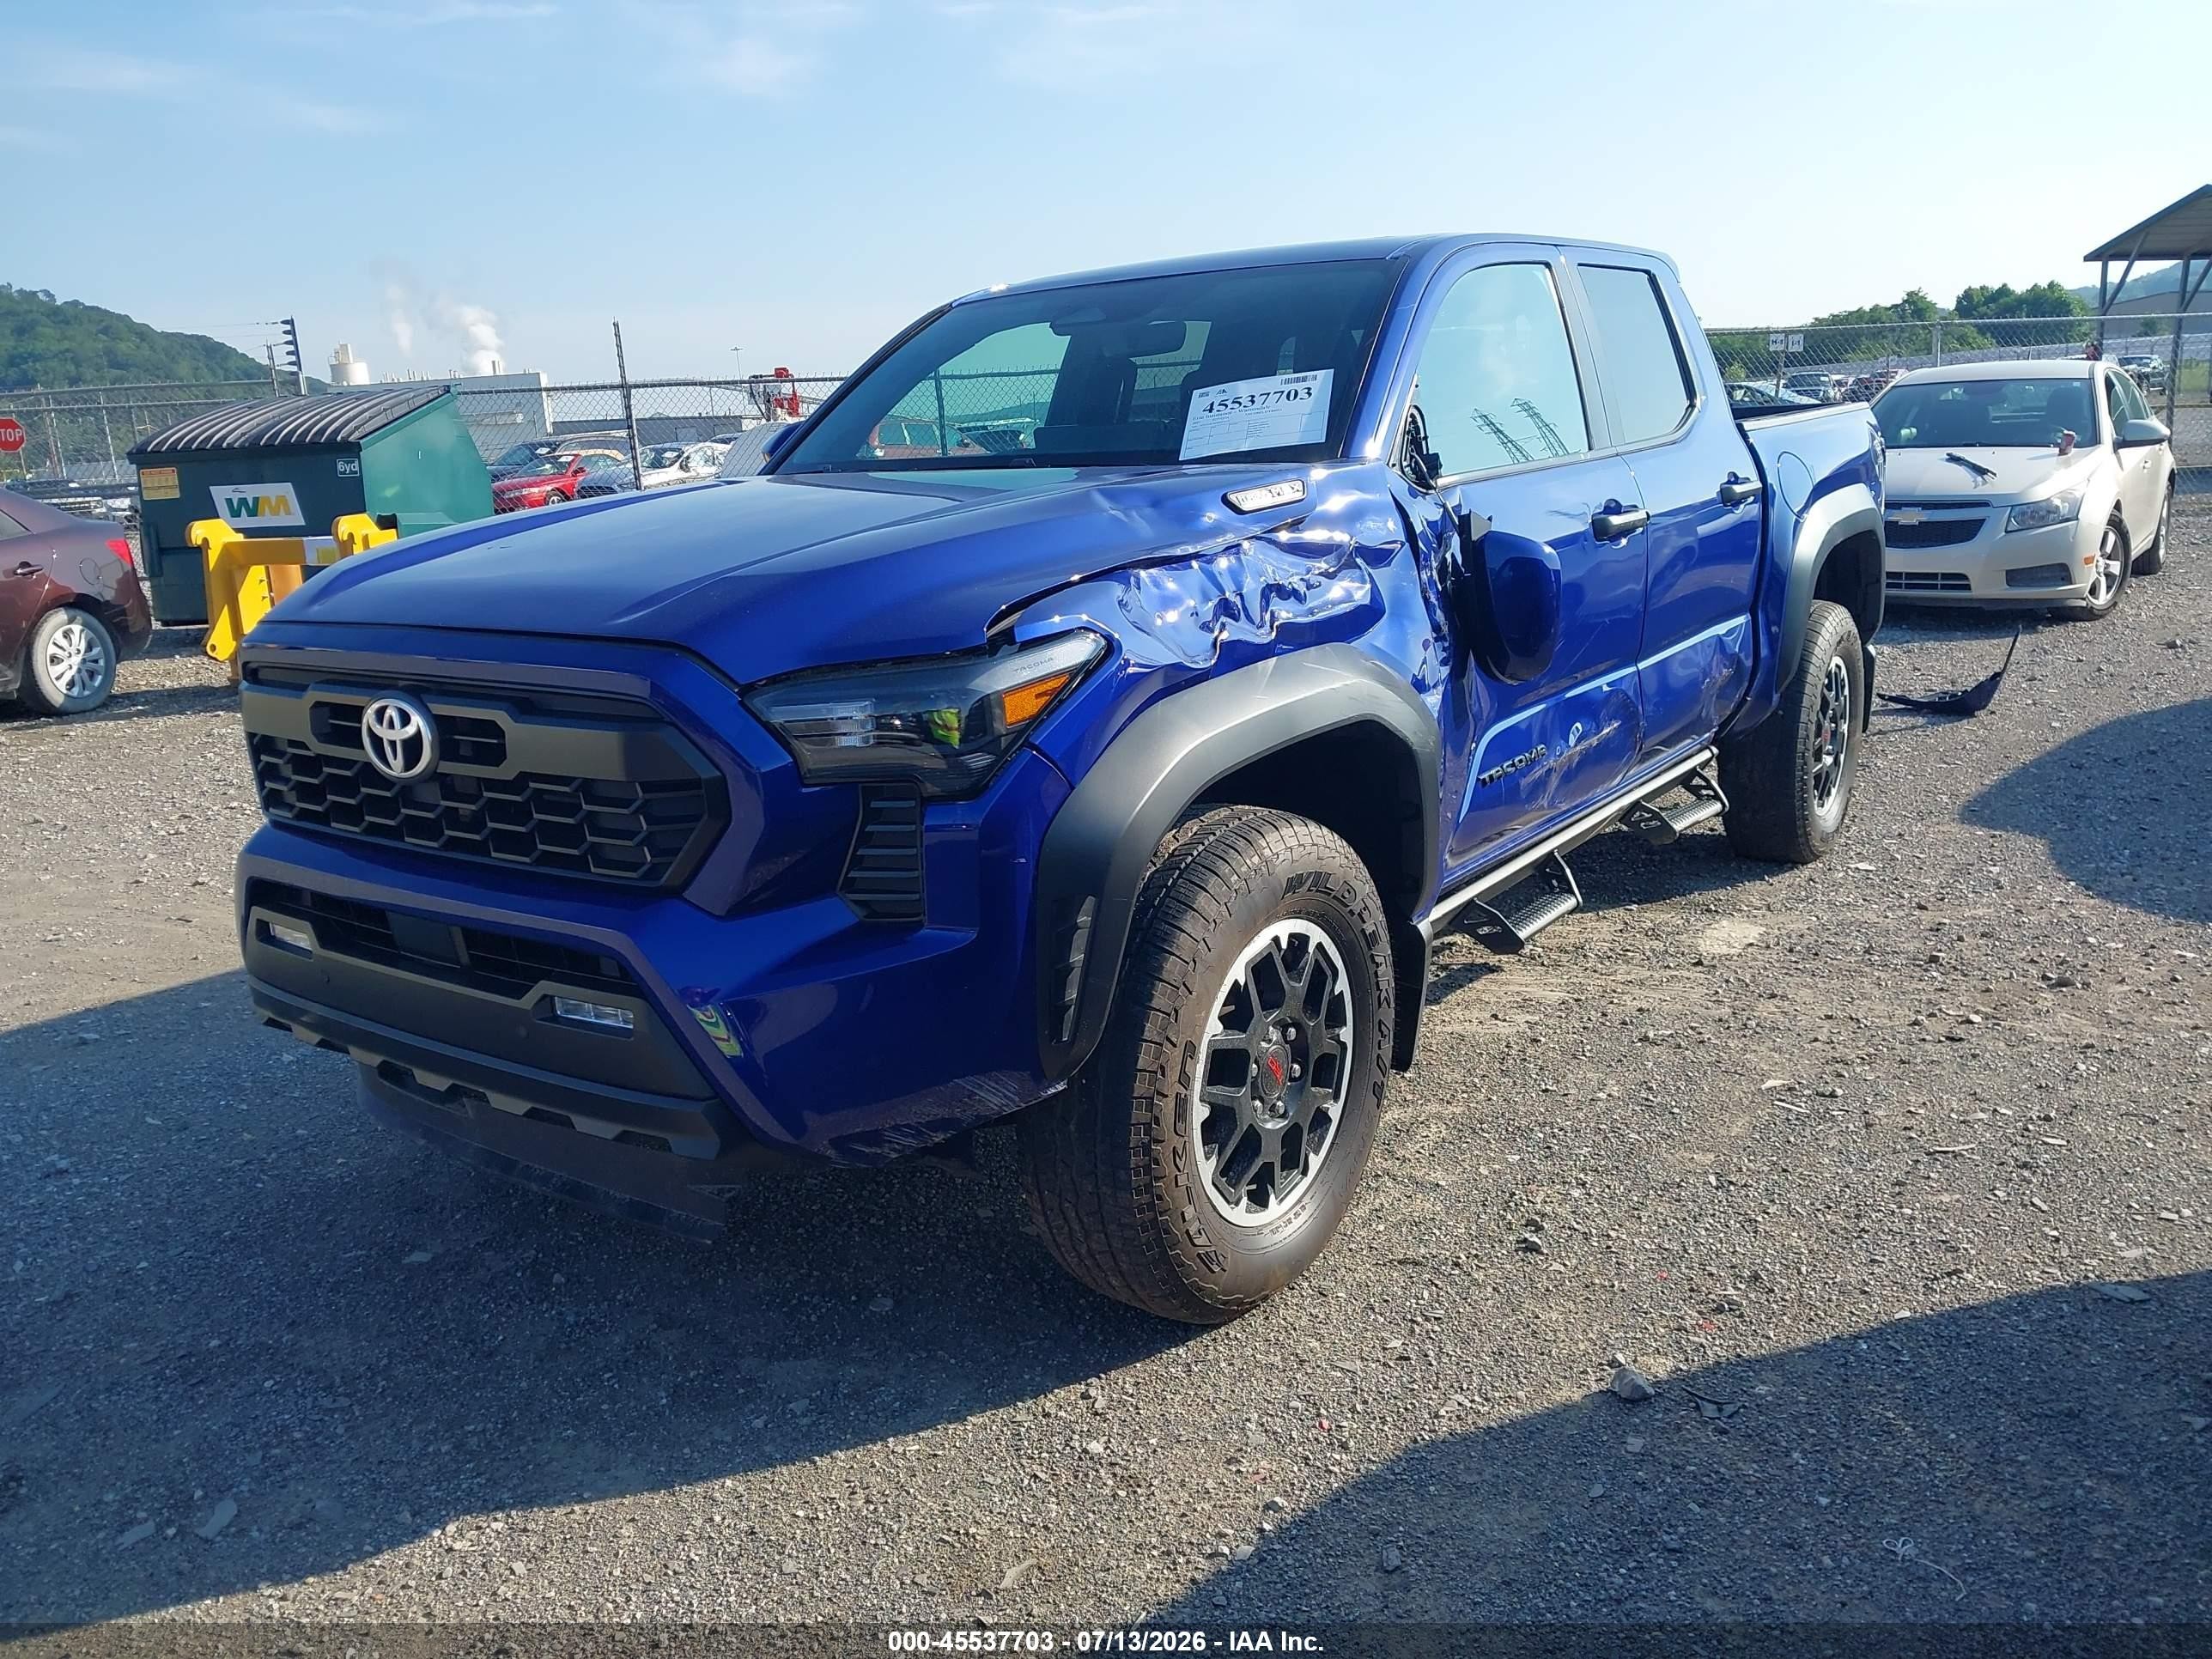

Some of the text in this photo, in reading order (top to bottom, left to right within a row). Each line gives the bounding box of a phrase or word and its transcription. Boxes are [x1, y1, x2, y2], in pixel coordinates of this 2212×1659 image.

[1202, 386, 1313, 413] 45537703
[0, 428, 22, 441] TOP
[338, 461, 358, 473] 6yd
[225, 495, 292, 518] WM
[1014, 657, 1054, 673] TACOMA
[1477, 743, 1547, 785] TACOMA
[1281, 870, 1392, 1008] WILDPEAK
